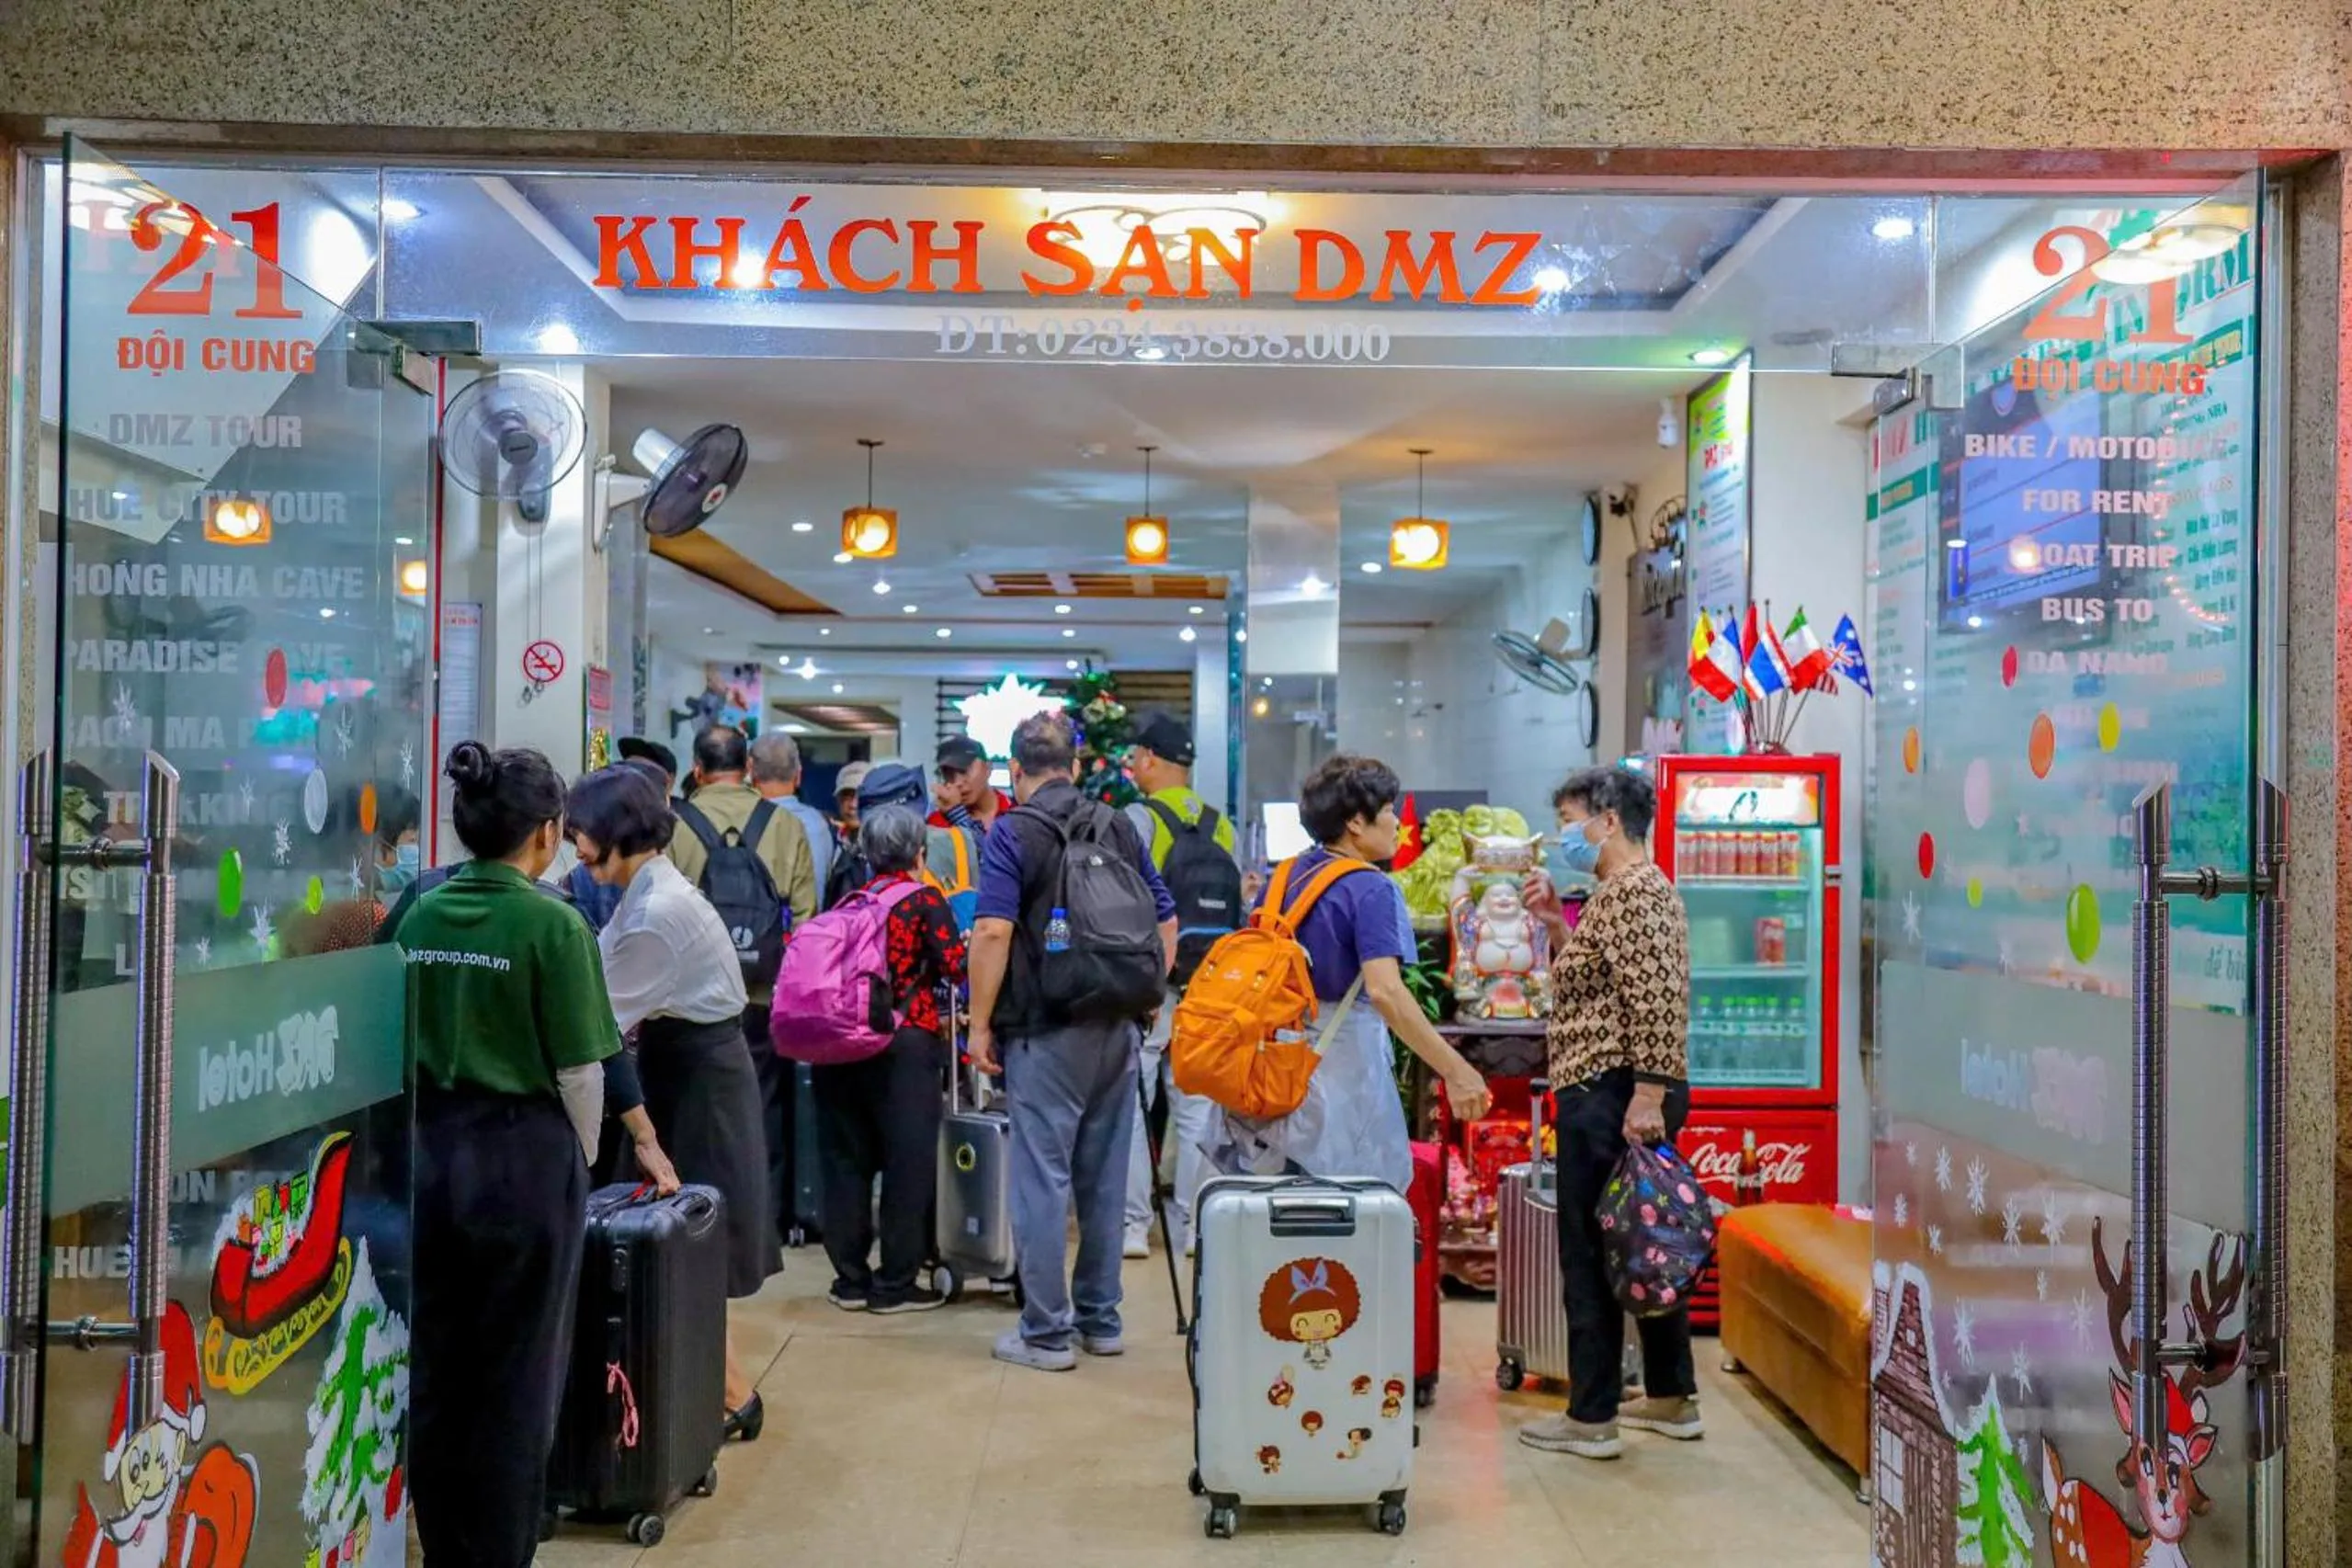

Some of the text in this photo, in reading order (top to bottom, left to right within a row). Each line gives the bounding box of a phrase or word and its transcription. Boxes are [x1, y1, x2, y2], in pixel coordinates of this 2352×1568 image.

[127, 200, 302, 319] 21
[592, 196, 1543, 312] KHÁCH SẠN DMZ
[2023, 224, 2194, 344] 21
[118, 329, 316, 376] ĐỘI CUNG
[2093, 359, 2206, 395] CUNG
[108, 414, 302, 449] DMZ TOUR
[1965, 434, 2037, 458] BIKE
[2023, 489, 2171, 516] FOR RENT
[2022, 544, 2098, 567] OAT
[2108, 544, 2177, 569] TRIP
[181, 564, 258, 597] NHA
[274, 566, 364, 599] CAVE
[2041, 598, 2153, 622] BUS TO
[2026, 651, 2068, 673] DA
[165, 717, 225, 748] MA
